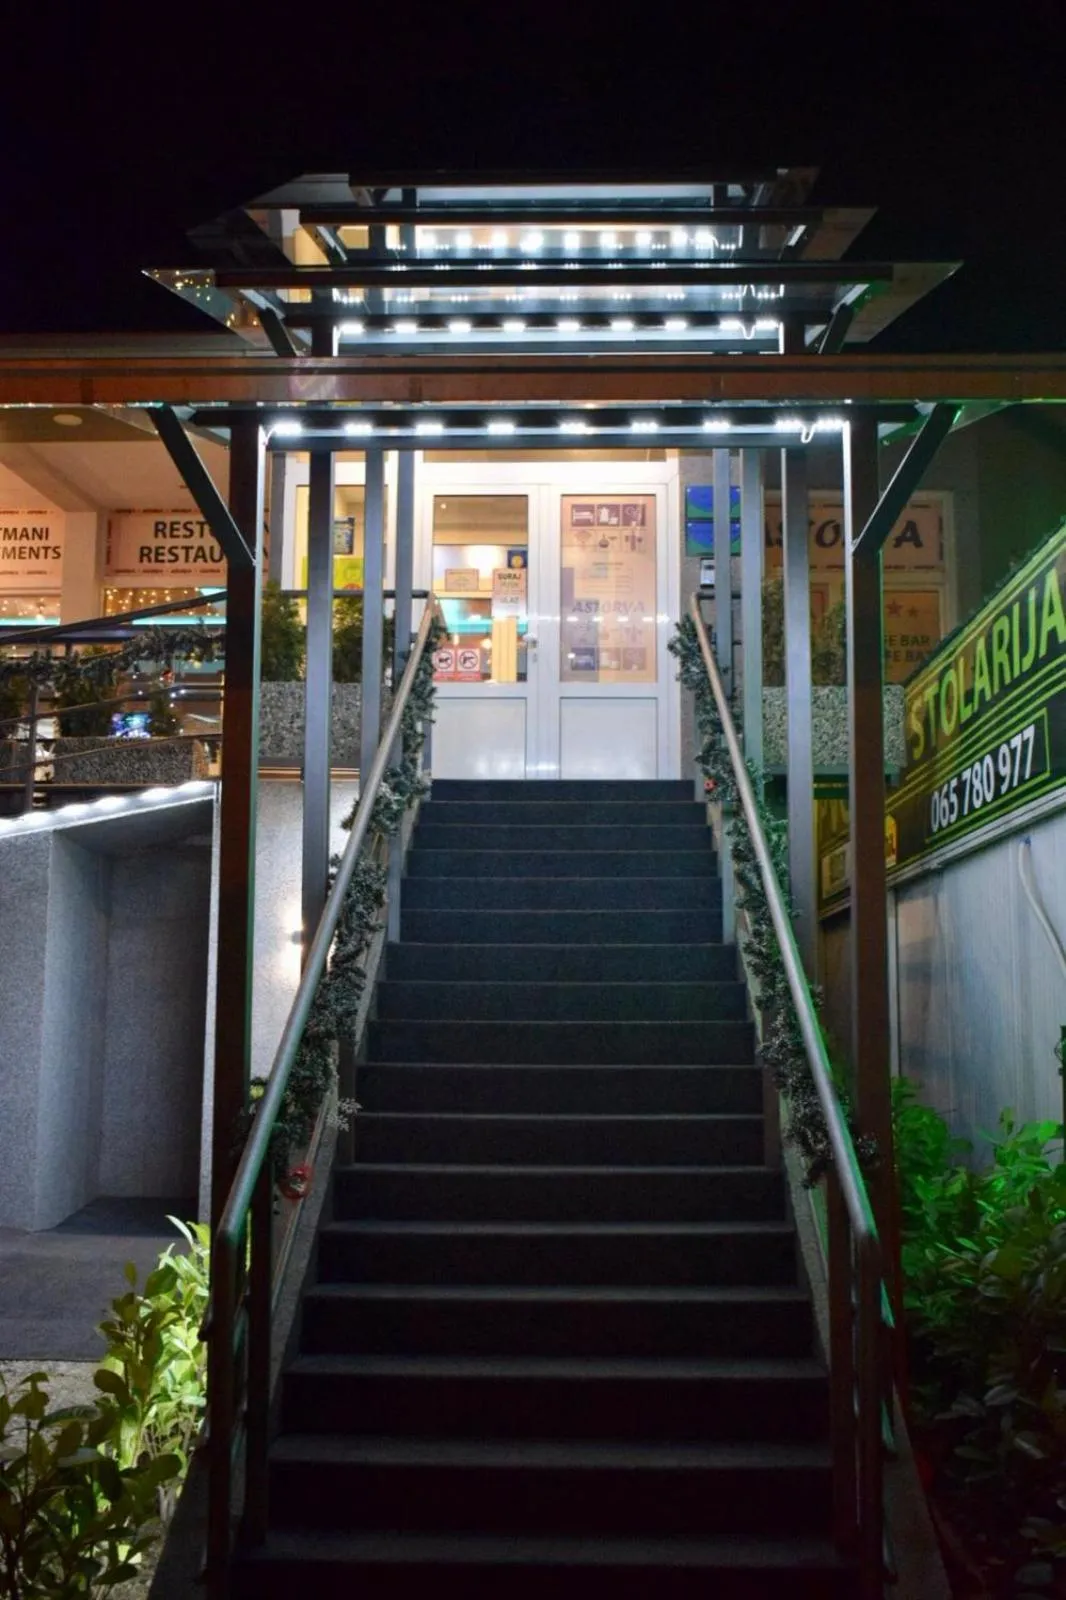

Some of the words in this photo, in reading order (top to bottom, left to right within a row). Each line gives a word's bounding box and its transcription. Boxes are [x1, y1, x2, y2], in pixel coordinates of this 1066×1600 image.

[0, 527, 50, 541] MANI
[153, 521, 212, 539] REST
[0, 546, 62, 560] MENTS
[139, 546, 224, 564] RESTAU
[910, 567, 1066, 761] STOLARIJA
[931, 783, 958, 832] 065
[961, 754, 995, 816] 780
[998, 724, 1036, 794] 977
